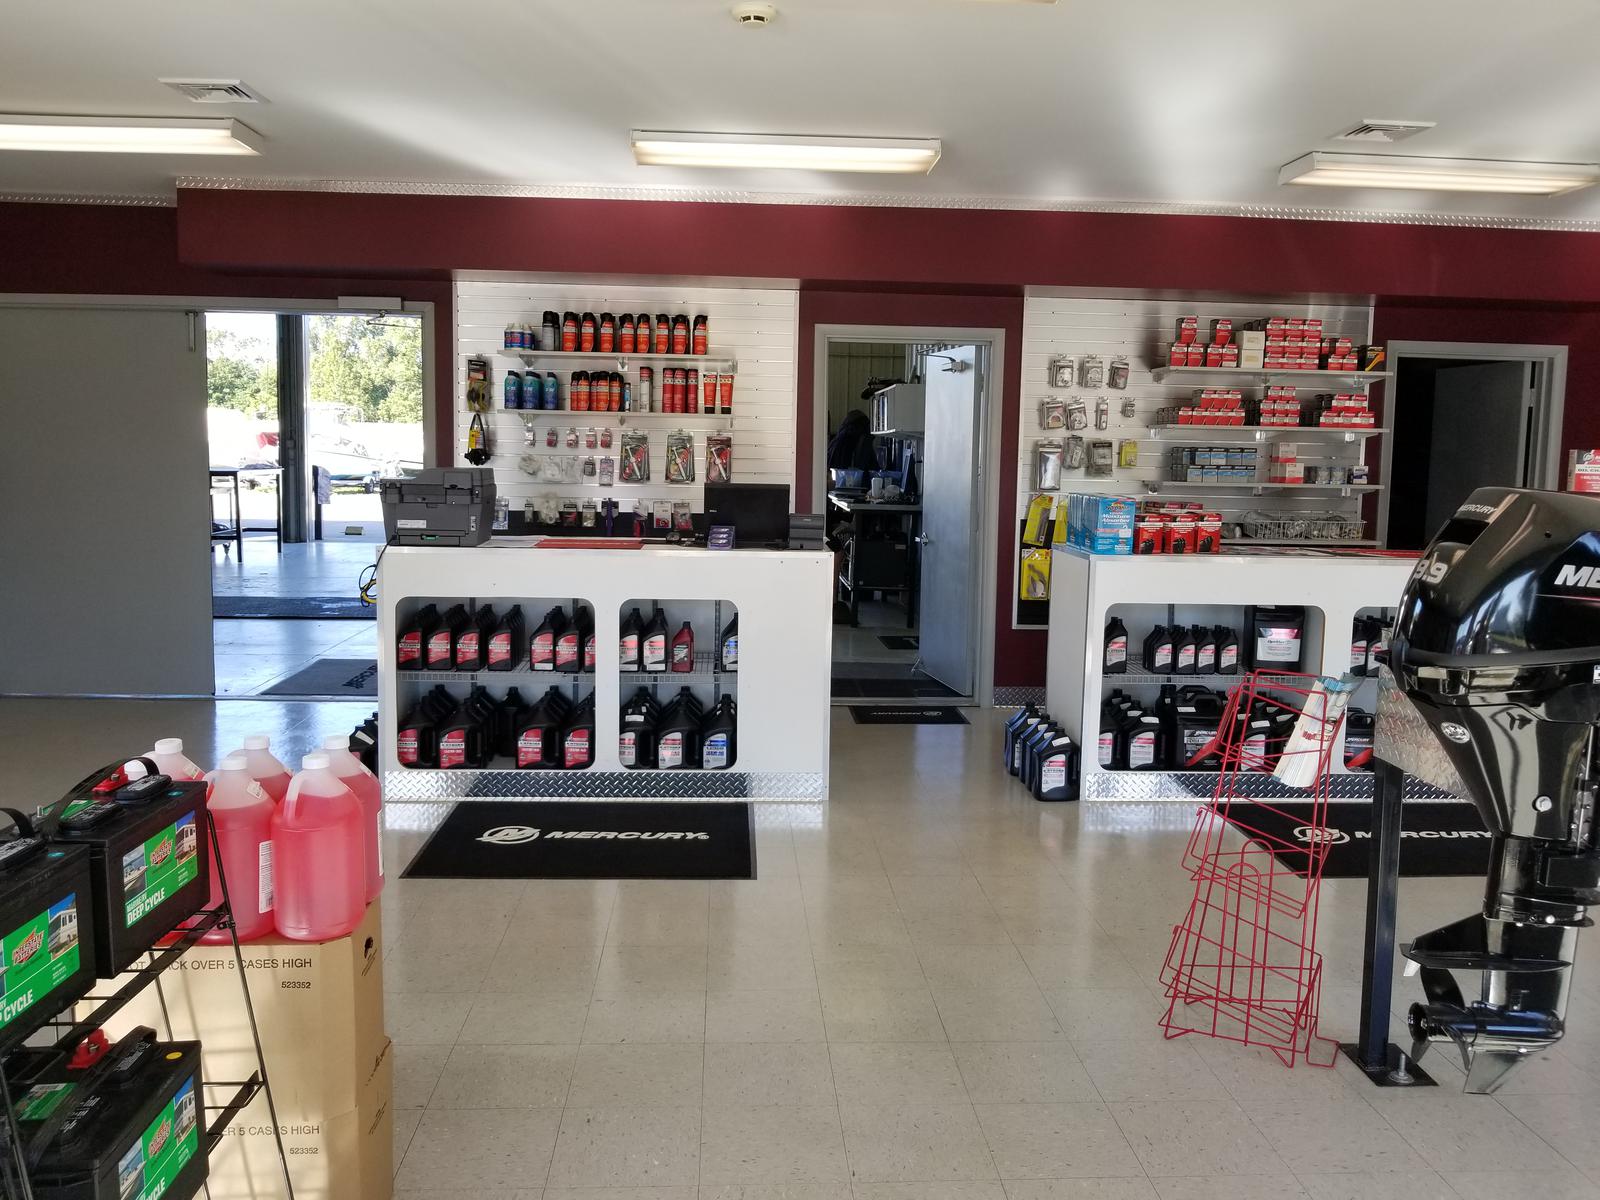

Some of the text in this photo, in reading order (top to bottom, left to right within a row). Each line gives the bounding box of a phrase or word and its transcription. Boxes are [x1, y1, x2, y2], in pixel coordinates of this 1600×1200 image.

[544, 830, 705, 840] MERCURY
[127, 887, 165, 926] DEEP CYCLE
[191, 960, 225, 970] OVER
[228, 960, 235, 969] 5
[240, 959, 279, 969] CASES
[282, 958, 312, 969] HIGH
[281, 981, 311, 989] 523352
[4, 989, 34, 1022] CYCLE
[239, 1127, 246, 1136] 5
[291, 1125, 320, 1135] HIGH
